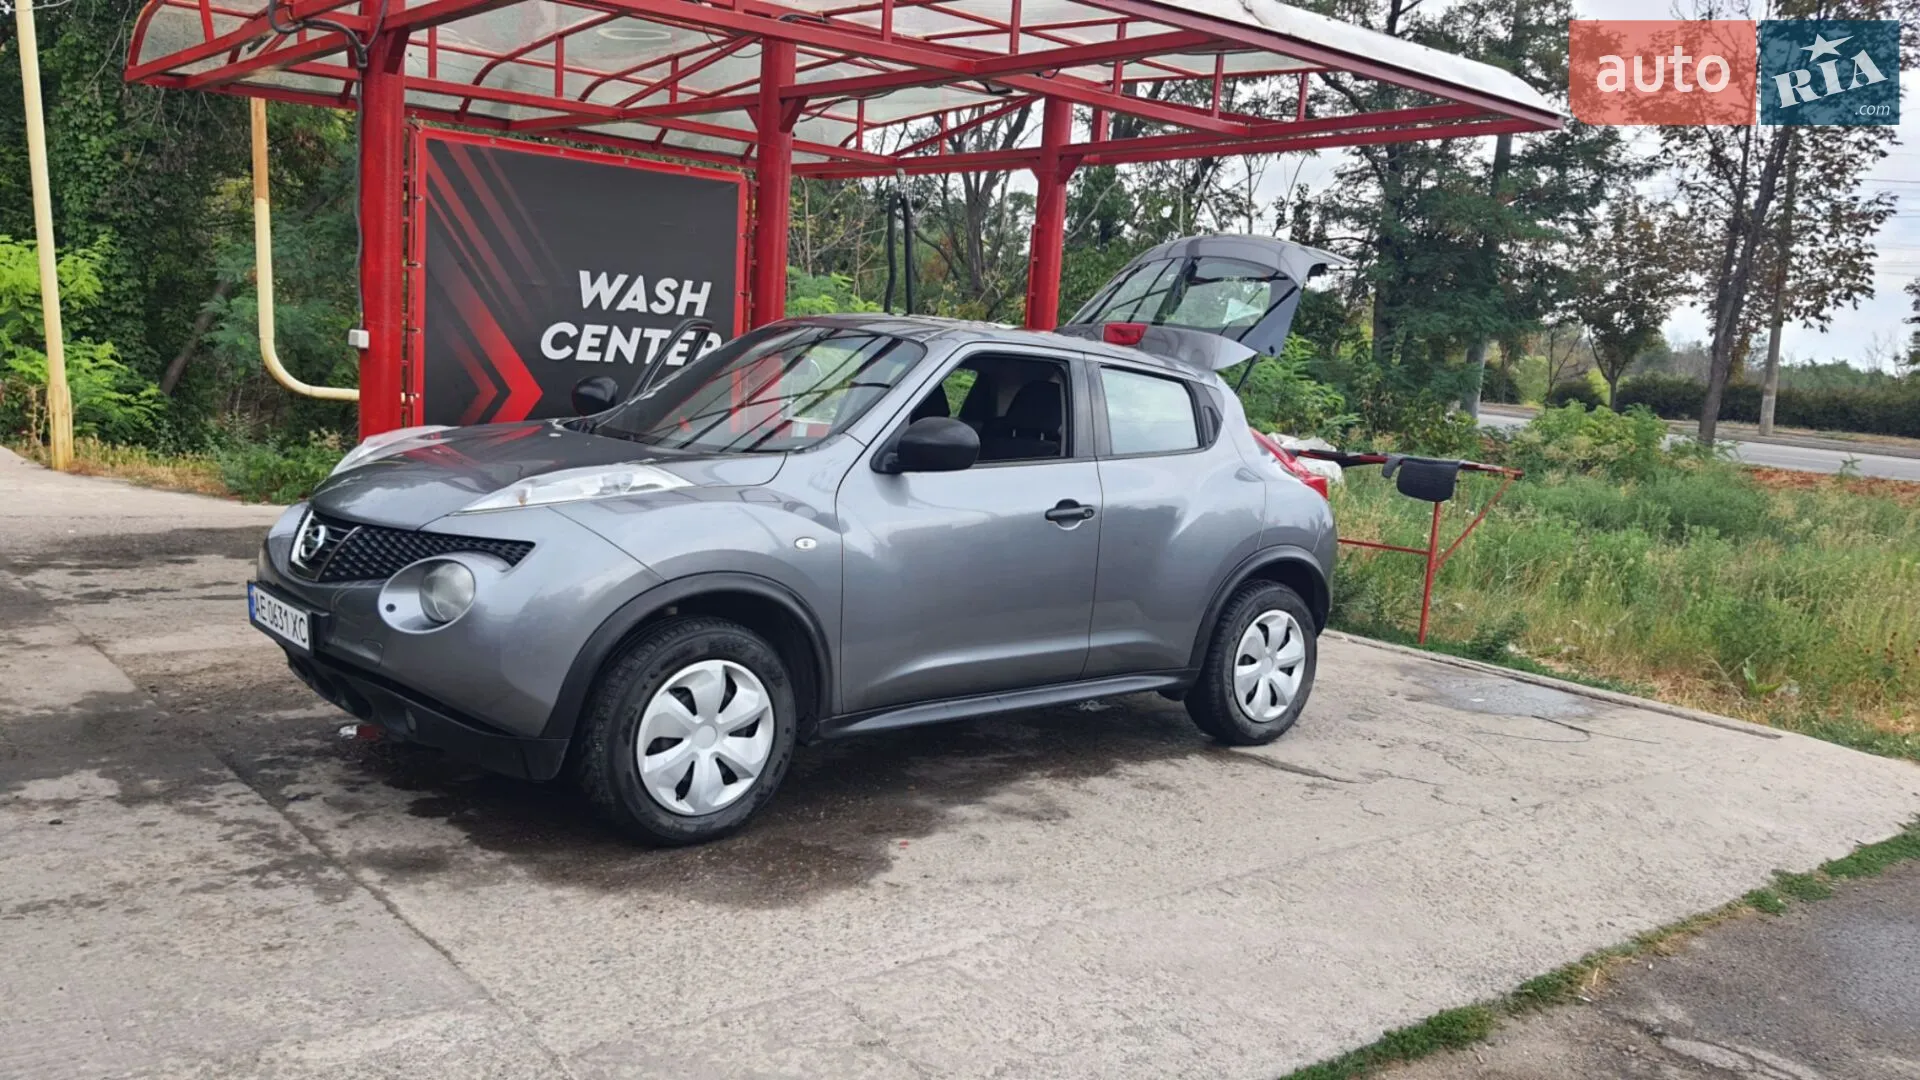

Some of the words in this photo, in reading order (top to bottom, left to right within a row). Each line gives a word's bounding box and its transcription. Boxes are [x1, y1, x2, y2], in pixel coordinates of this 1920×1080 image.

[579, 270, 712, 317] WASH
[255, 592, 267, 621] AE
[267, 600, 290, 634] 0631
[290, 612, 307, 643] XC
